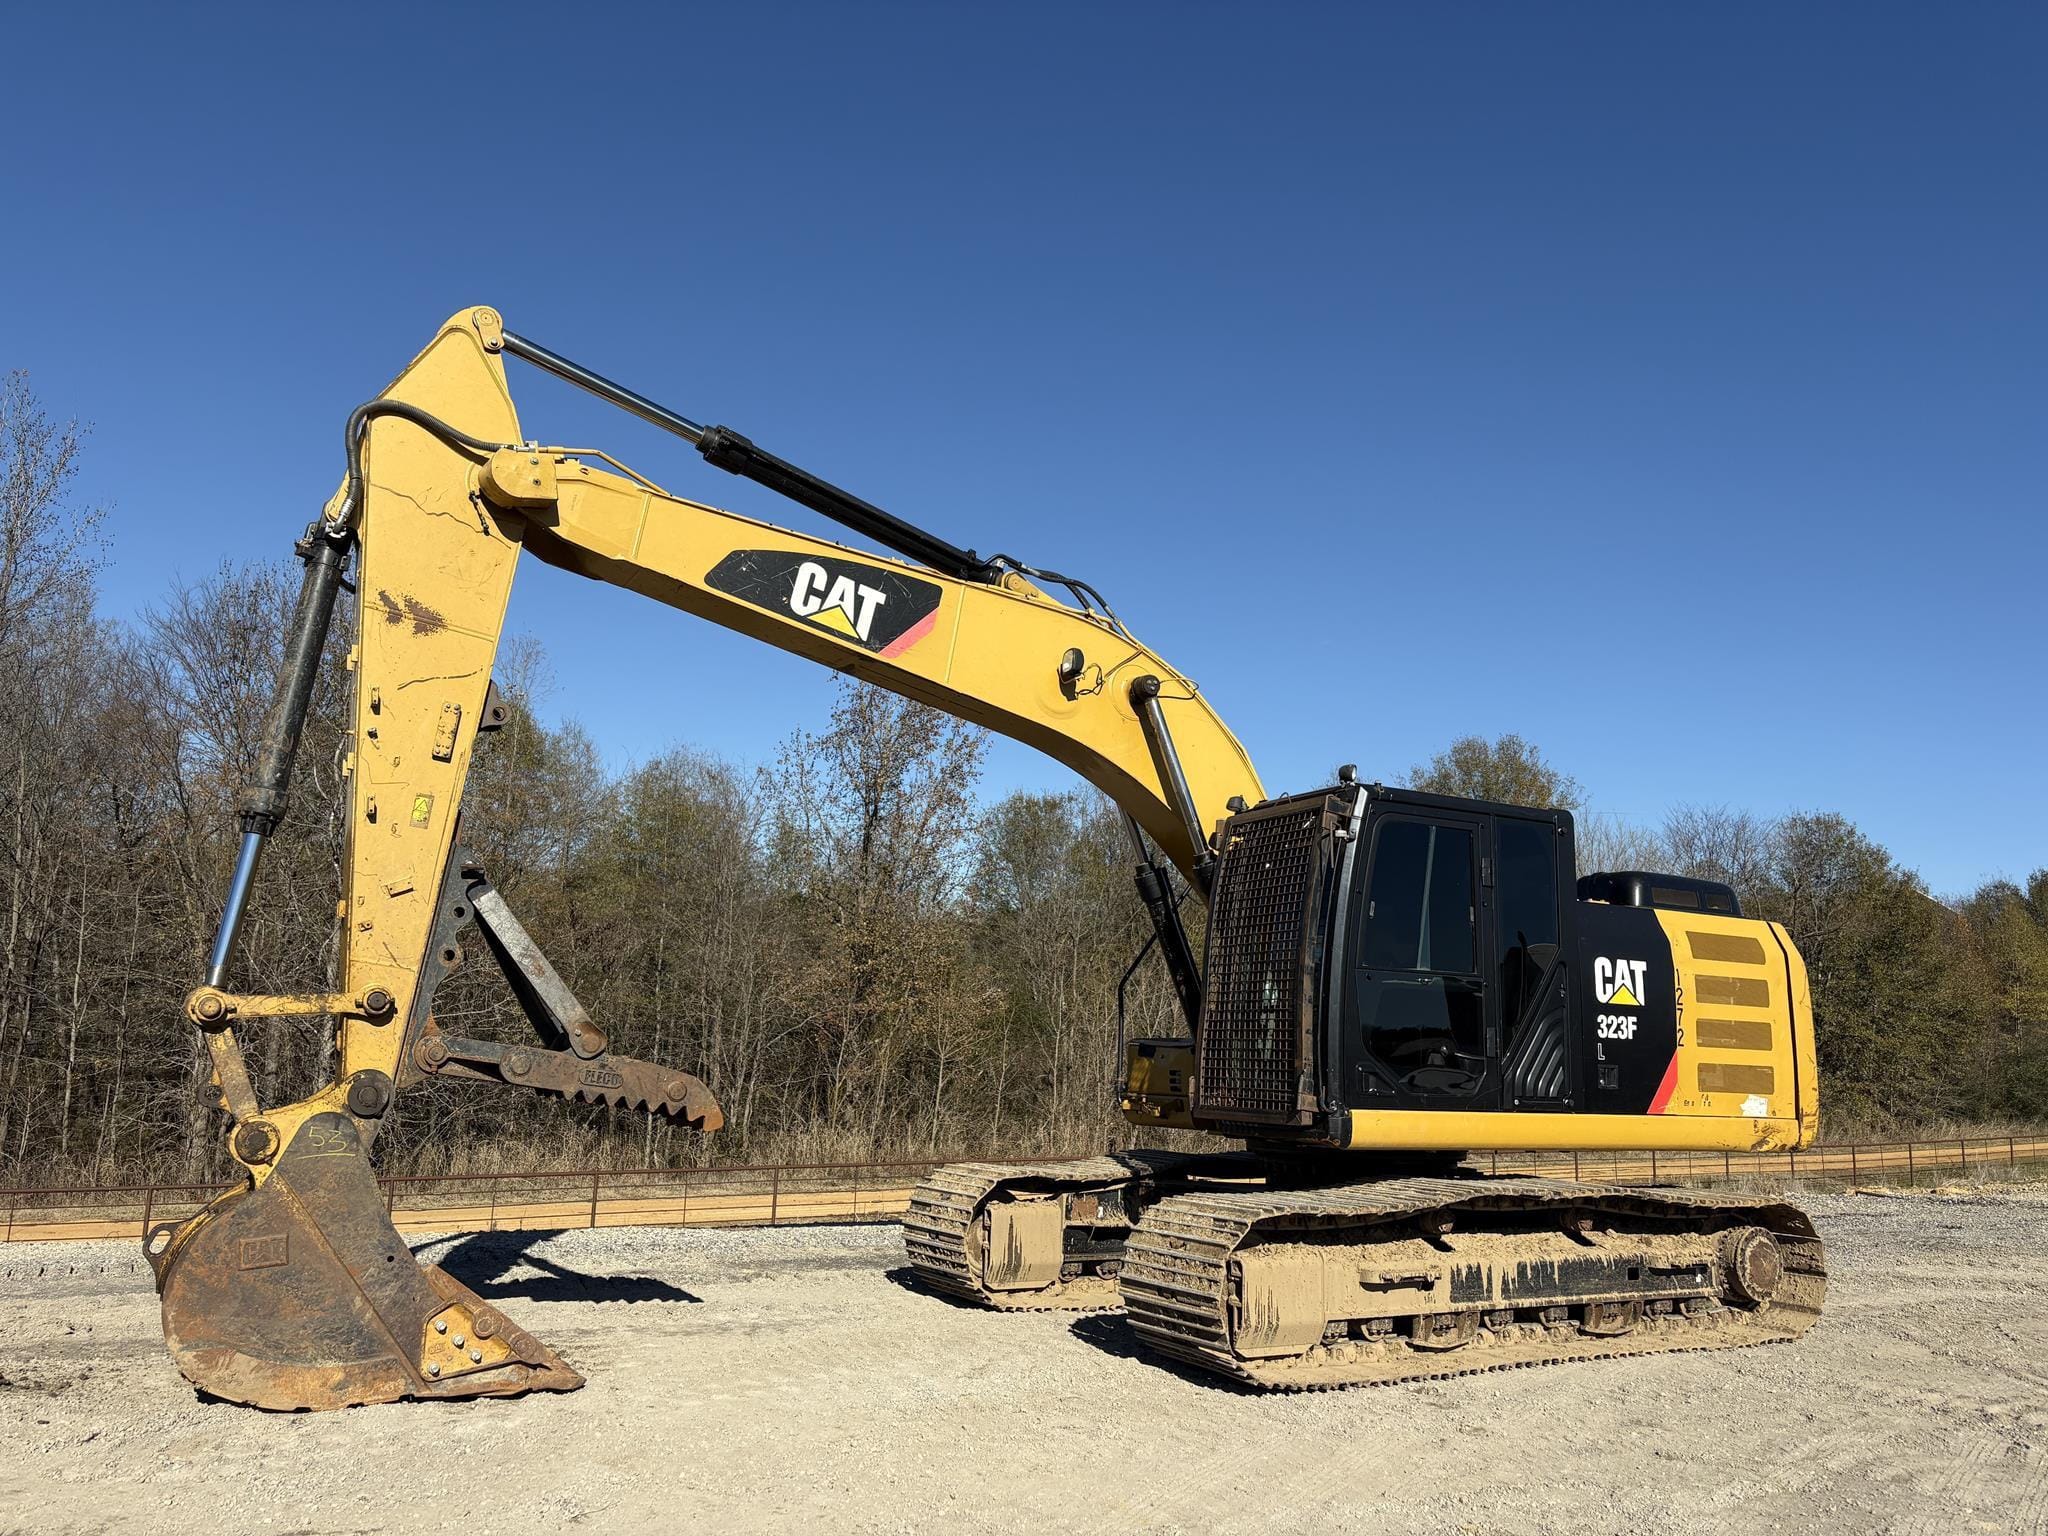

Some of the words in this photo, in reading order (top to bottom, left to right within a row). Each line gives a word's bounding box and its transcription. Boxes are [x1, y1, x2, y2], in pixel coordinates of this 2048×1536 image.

[790, 562, 887, 641] CAT
[1594, 956, 1647, 1006] CAT
[1597, 1014, 1638, 1040] 323F
[1597, 1043, 1606, 1060] L
[308, 1126, 348, 1153] 53
